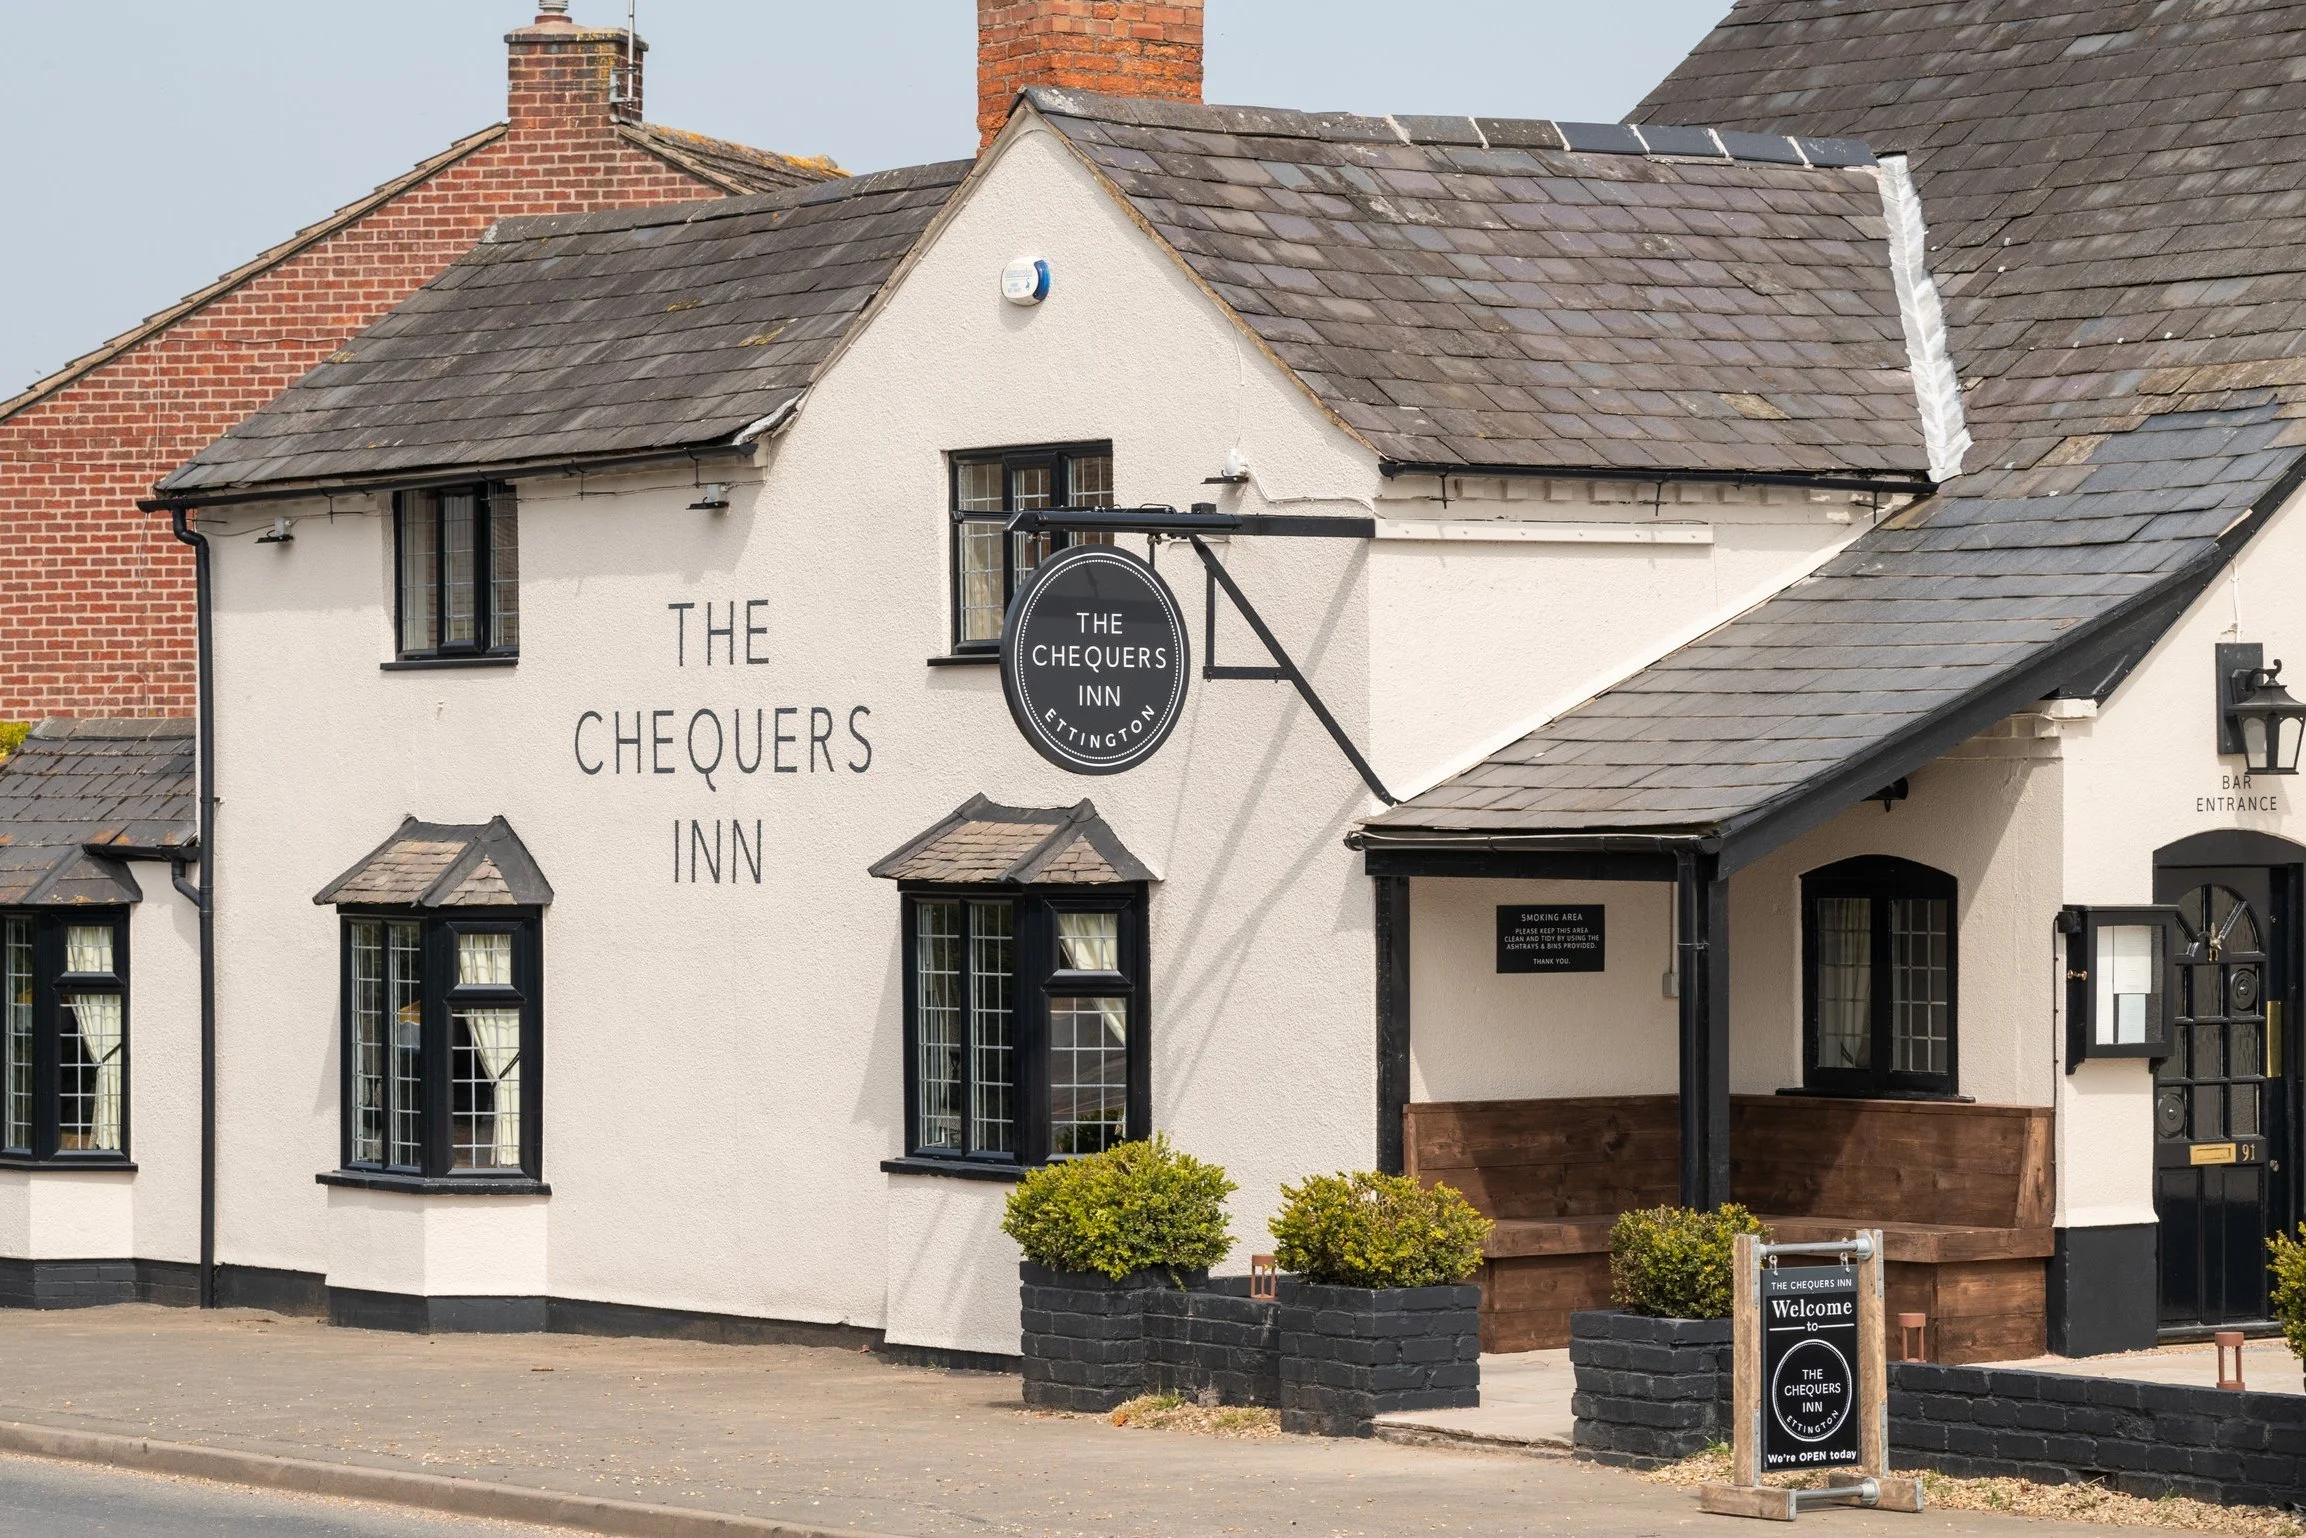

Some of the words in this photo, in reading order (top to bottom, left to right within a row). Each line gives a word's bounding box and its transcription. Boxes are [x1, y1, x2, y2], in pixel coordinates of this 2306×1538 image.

[1076, 612, 1123, 634] THE
[668, 600, 769, 667] THE
[1032, 644, 1167, 673] CHEQUERS
[1079, 685, 1121, 707] INN
[1044, 704, 1155, 749] ETTINGTON
[575, 705, 872, 792] CHEQUERS
[2222, 775, 2252, 790] BAR
[2196, 796, 2277, 812] ENTRANCE
[674, 819, 762, 884] INN
[1521, 913, 1559, 922] SMOKING
[1562, 913, 1583, 921] AREA
[2242, 1143, 2256, 1161] 91
[1771, 1281, 1788, 1290] THE
[1790, 1279, 1835, 1290] CHEQUERS
[1837, 1278, 1852, 1287] INN
[1771, 1299, 1853, 1319] Welcome
[1806, 1321, 1819, 1332] to
[1802, 1368, 1824, 1380] THE
[1784, 1382, 1841, 1397] CHEQUERS
[1802, 1401, 1823, 1413] INN
[1786, 1409, 1839, 1434] ETTINGTON
[1767, 1454, 1796, 1463] We're
[1799, 1451, 1827, 1462] OPEN
[1830, 1449, 1857, 1460] today
